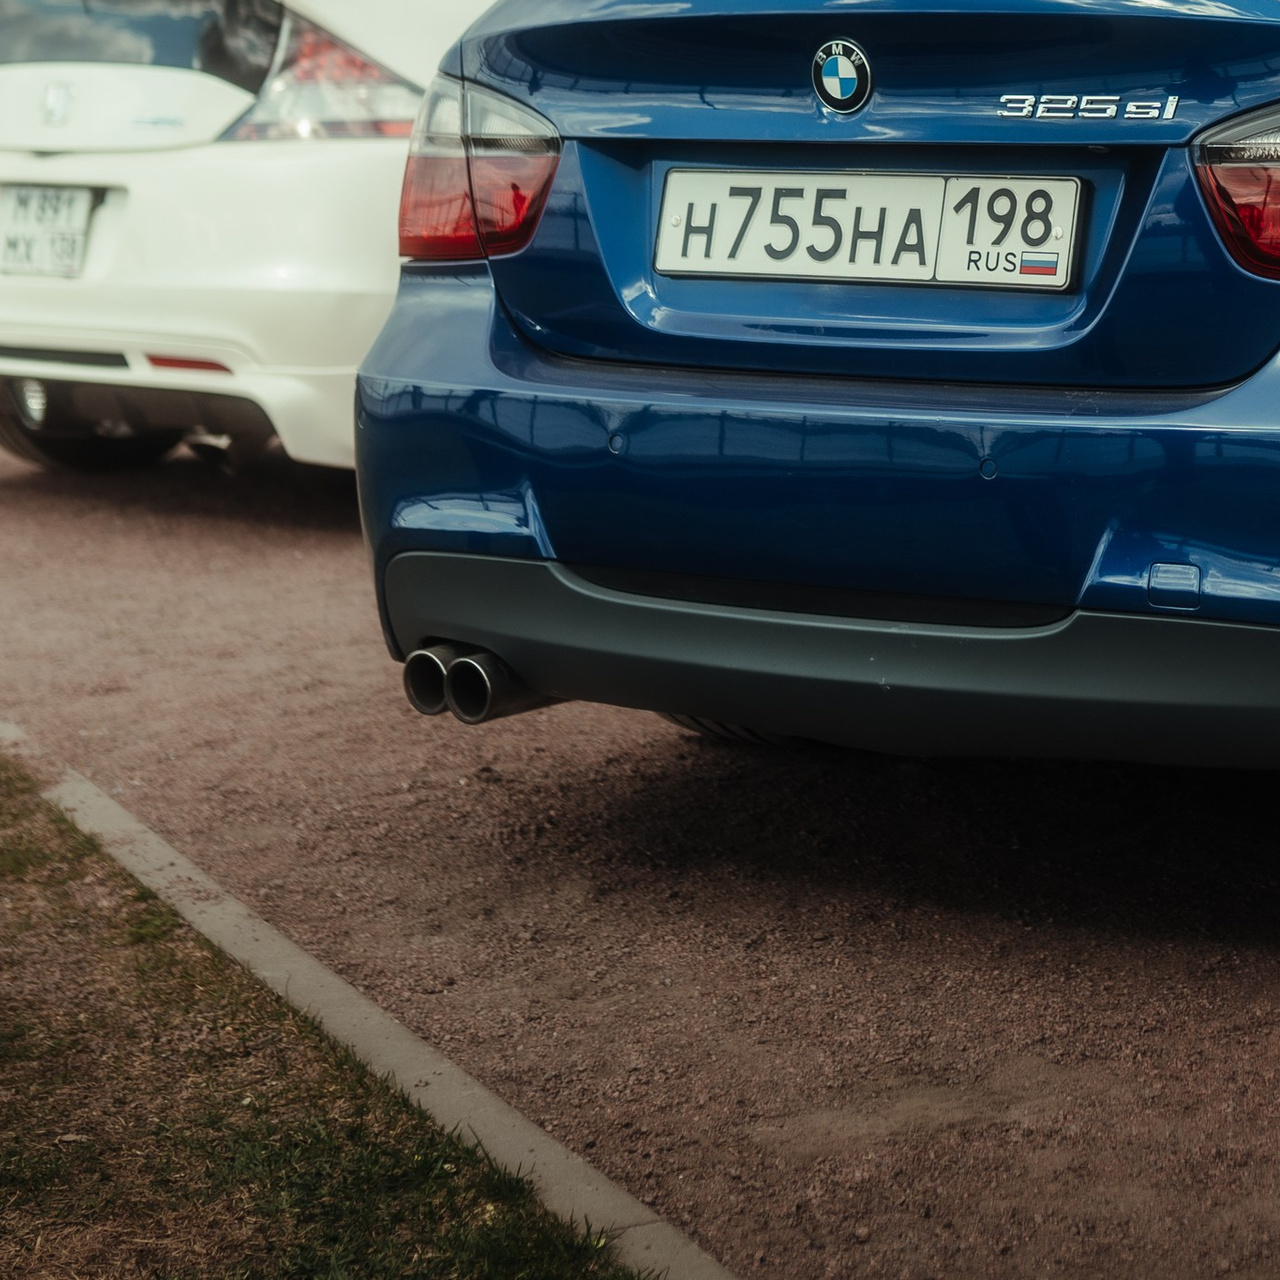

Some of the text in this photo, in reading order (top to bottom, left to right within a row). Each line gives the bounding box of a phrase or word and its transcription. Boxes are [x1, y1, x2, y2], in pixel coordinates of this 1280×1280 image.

[816, 43, 864, 67] BMW
[997, 95, 1180, 120] 325si
[681, 186, 1053, 266] H755HA 198
[967, 250, 1017, 273] RUS
